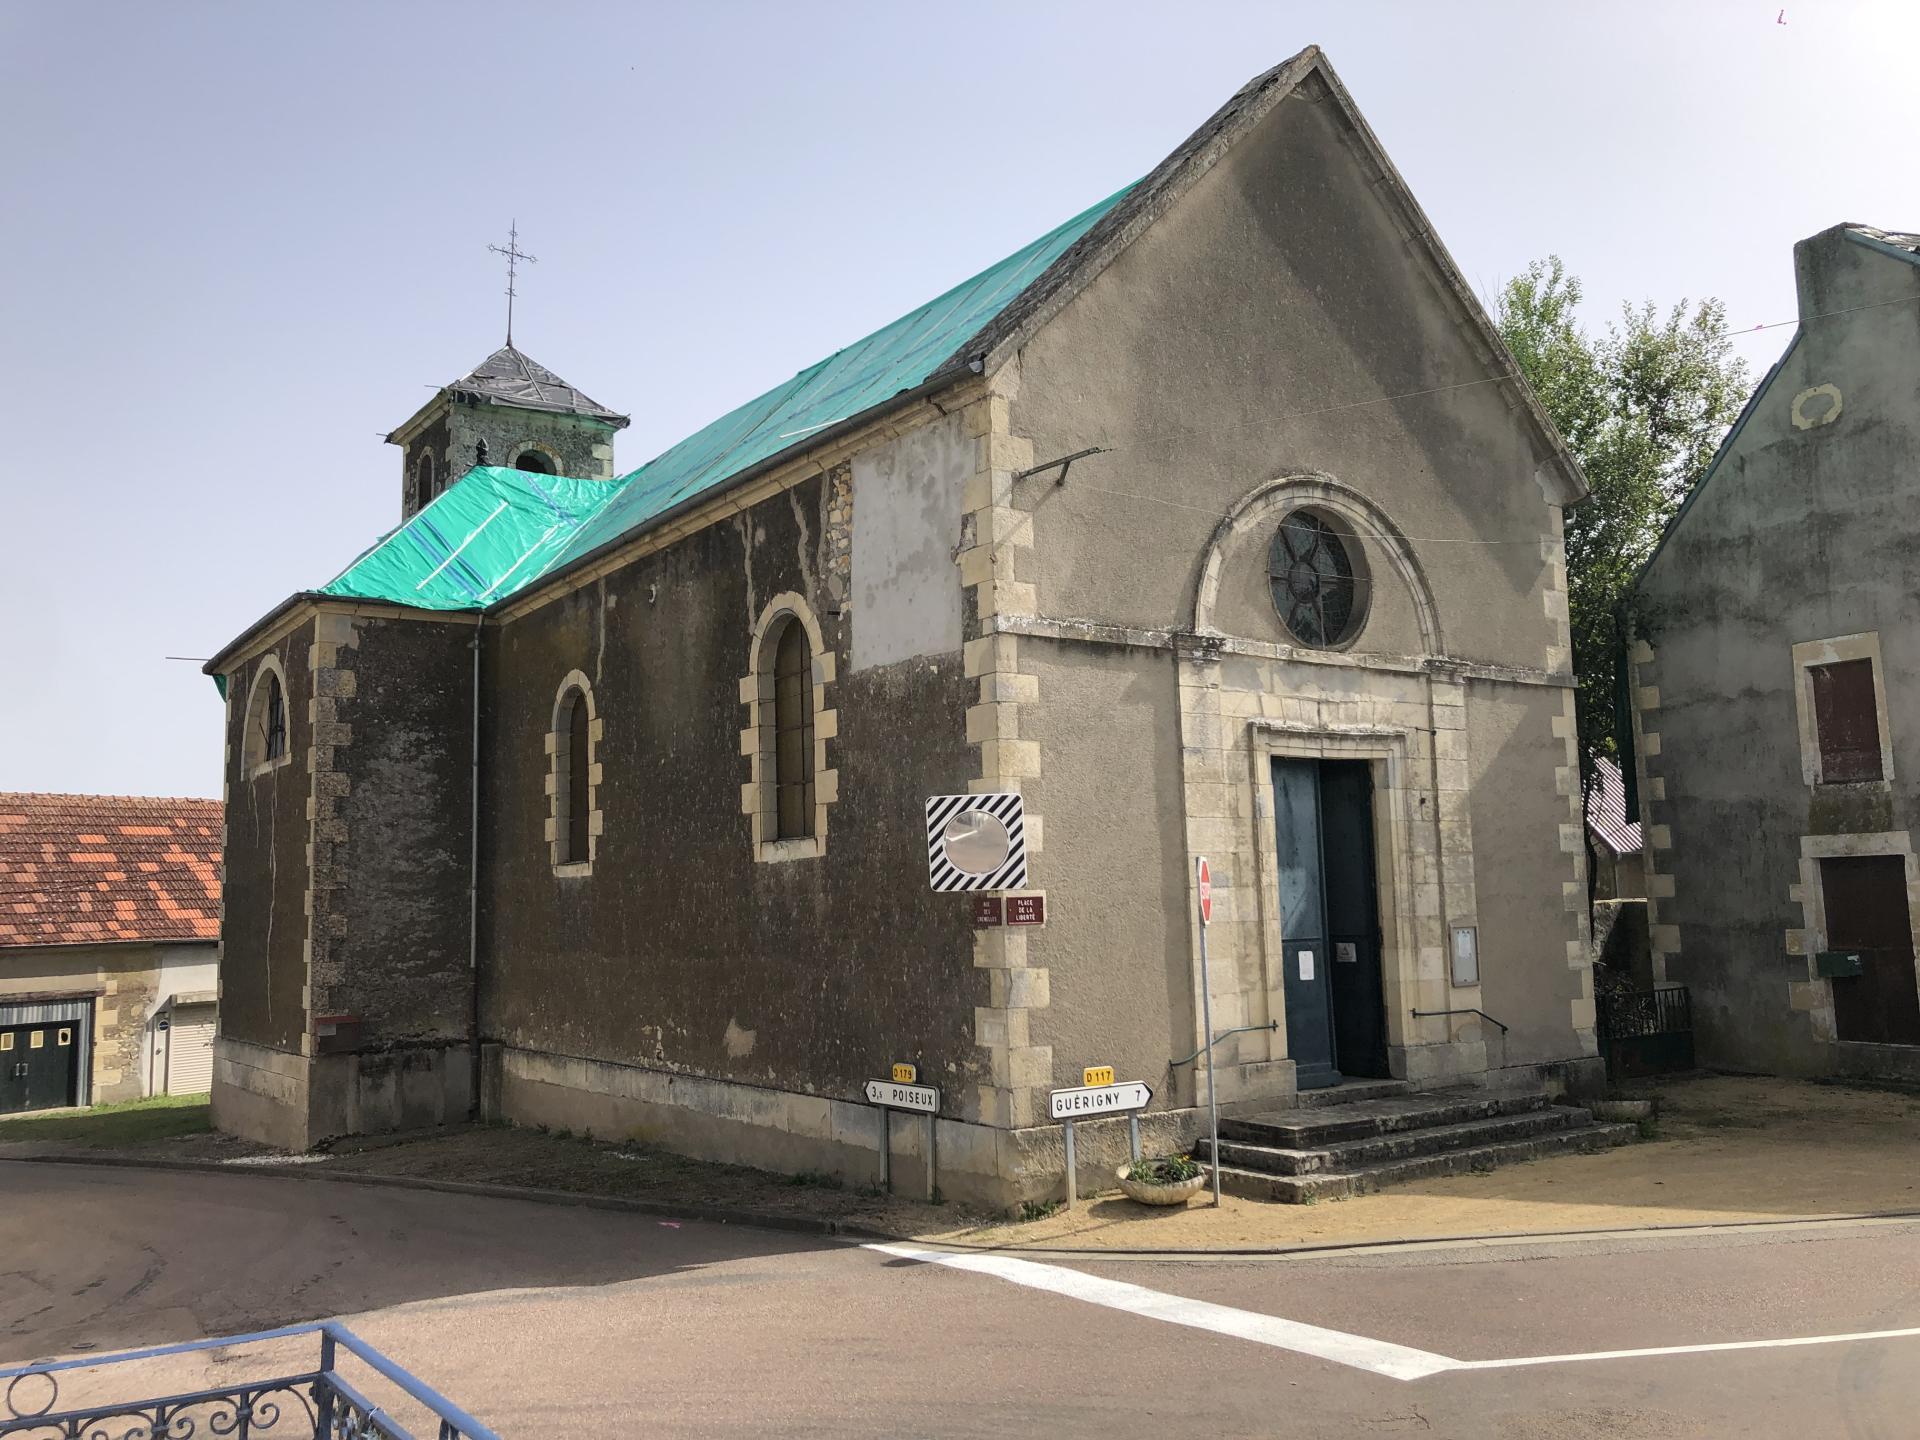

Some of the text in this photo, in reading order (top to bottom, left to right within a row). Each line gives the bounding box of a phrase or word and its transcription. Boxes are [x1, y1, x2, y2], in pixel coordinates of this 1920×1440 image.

[1017, 899, 1034, 907] PLACE
[1018, 906, 1034, 914] DE LA
[1015, 913, 1036, 921] LIBERTÉ
[899, 1068, 912, 1080] 179
[1086, 1070, 1111, 1083] D 117
[892, 1089, 933, 1107] POISEUX
[1056, 1089, 1141, 1112] GUÉRIGNY 7
